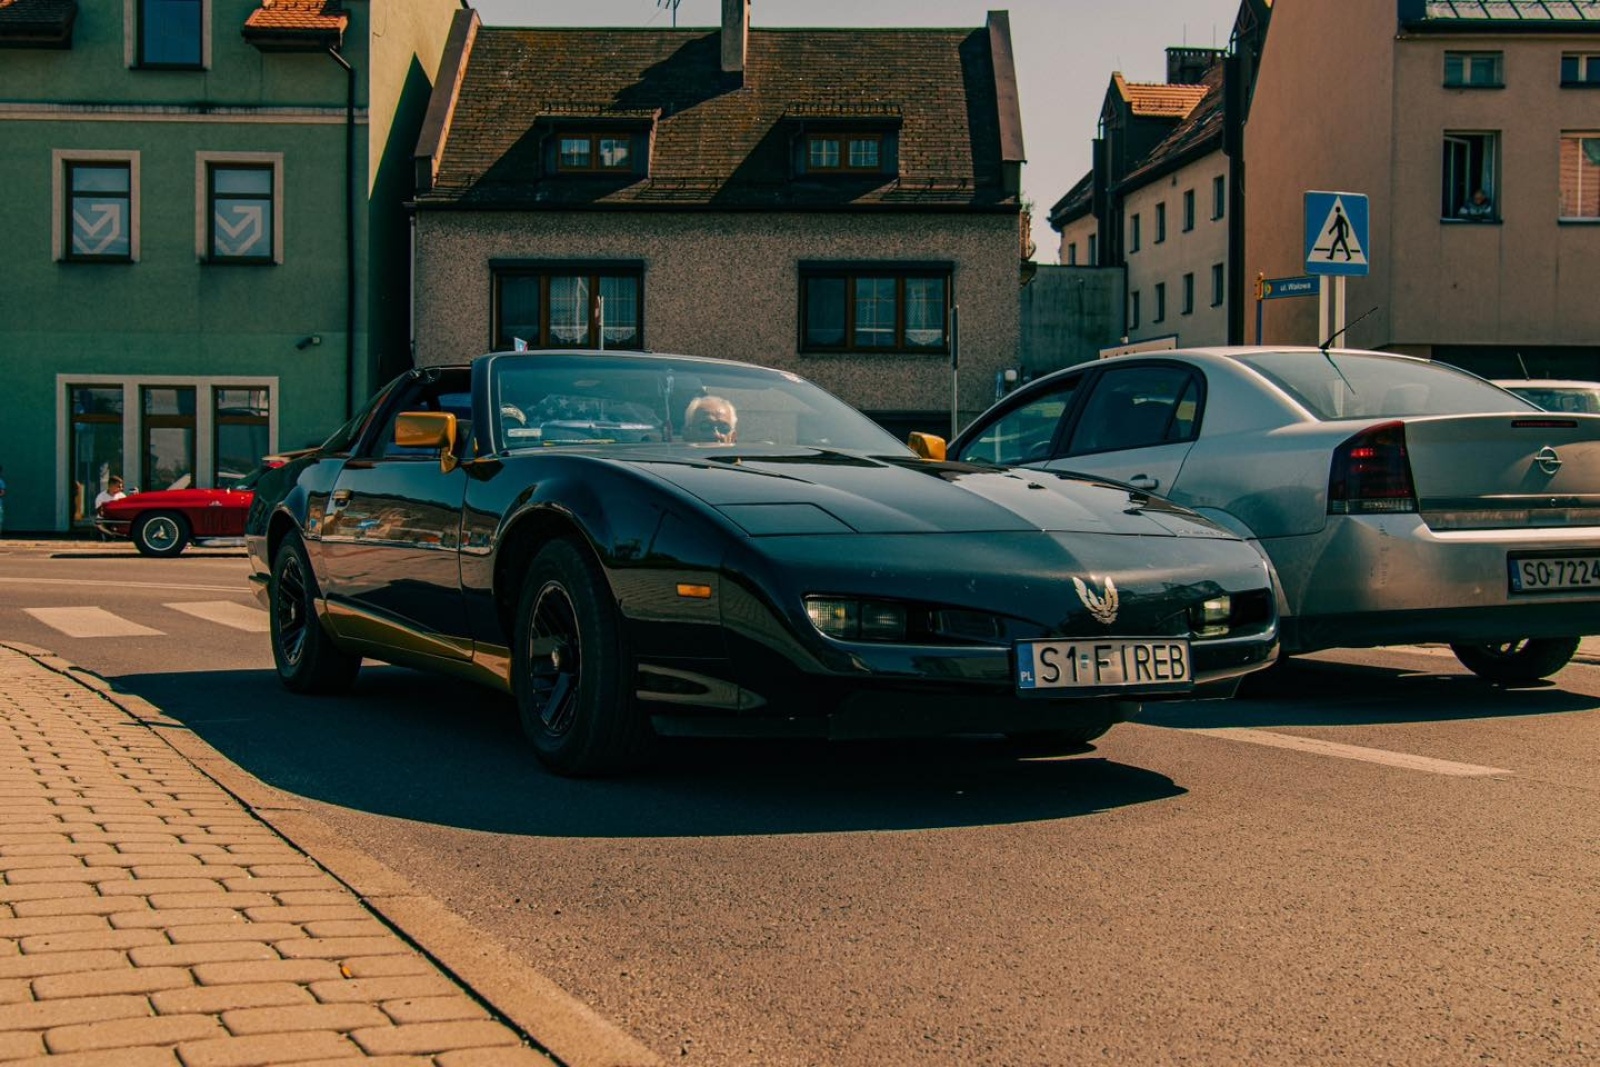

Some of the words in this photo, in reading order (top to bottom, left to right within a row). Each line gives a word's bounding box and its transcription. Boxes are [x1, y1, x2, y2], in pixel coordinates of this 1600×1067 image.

[1040, 646, 1078, 683] S1
[1094, 644, 1185, 682] FIREB
[1020, 671, 1034, 682] PL
